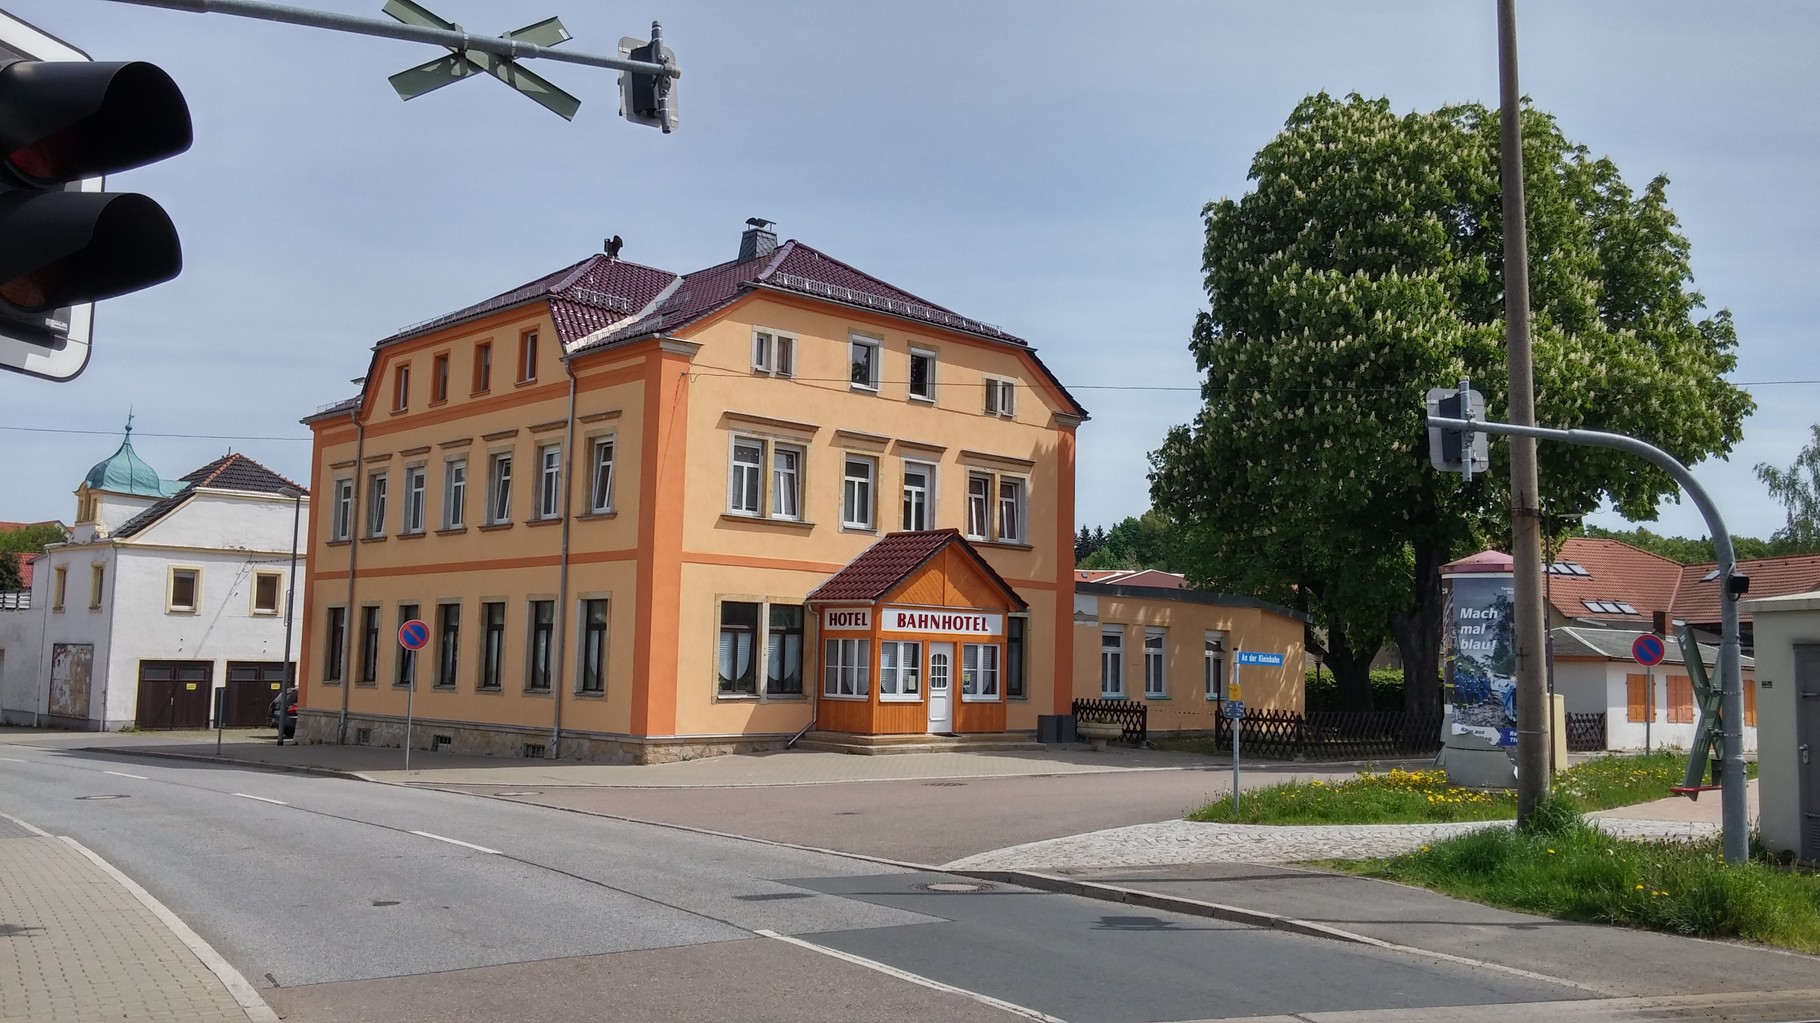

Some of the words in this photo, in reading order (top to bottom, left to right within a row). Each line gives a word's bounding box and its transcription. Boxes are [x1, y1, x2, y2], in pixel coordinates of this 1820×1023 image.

[1460, 607, 1498, 619] Mach
[829, 612, 867, 627] HOTEL
[897, 613, 988, 632] BAHNHOTEL
[1460, 623, 1486, 635] mal
[1460, 639, 1497, 651] blau!
[1241, 653, 1248, 661] An
[1249, 654, 1257, 662] der
[1258, 655, 1280, 664] Kleinbahn
